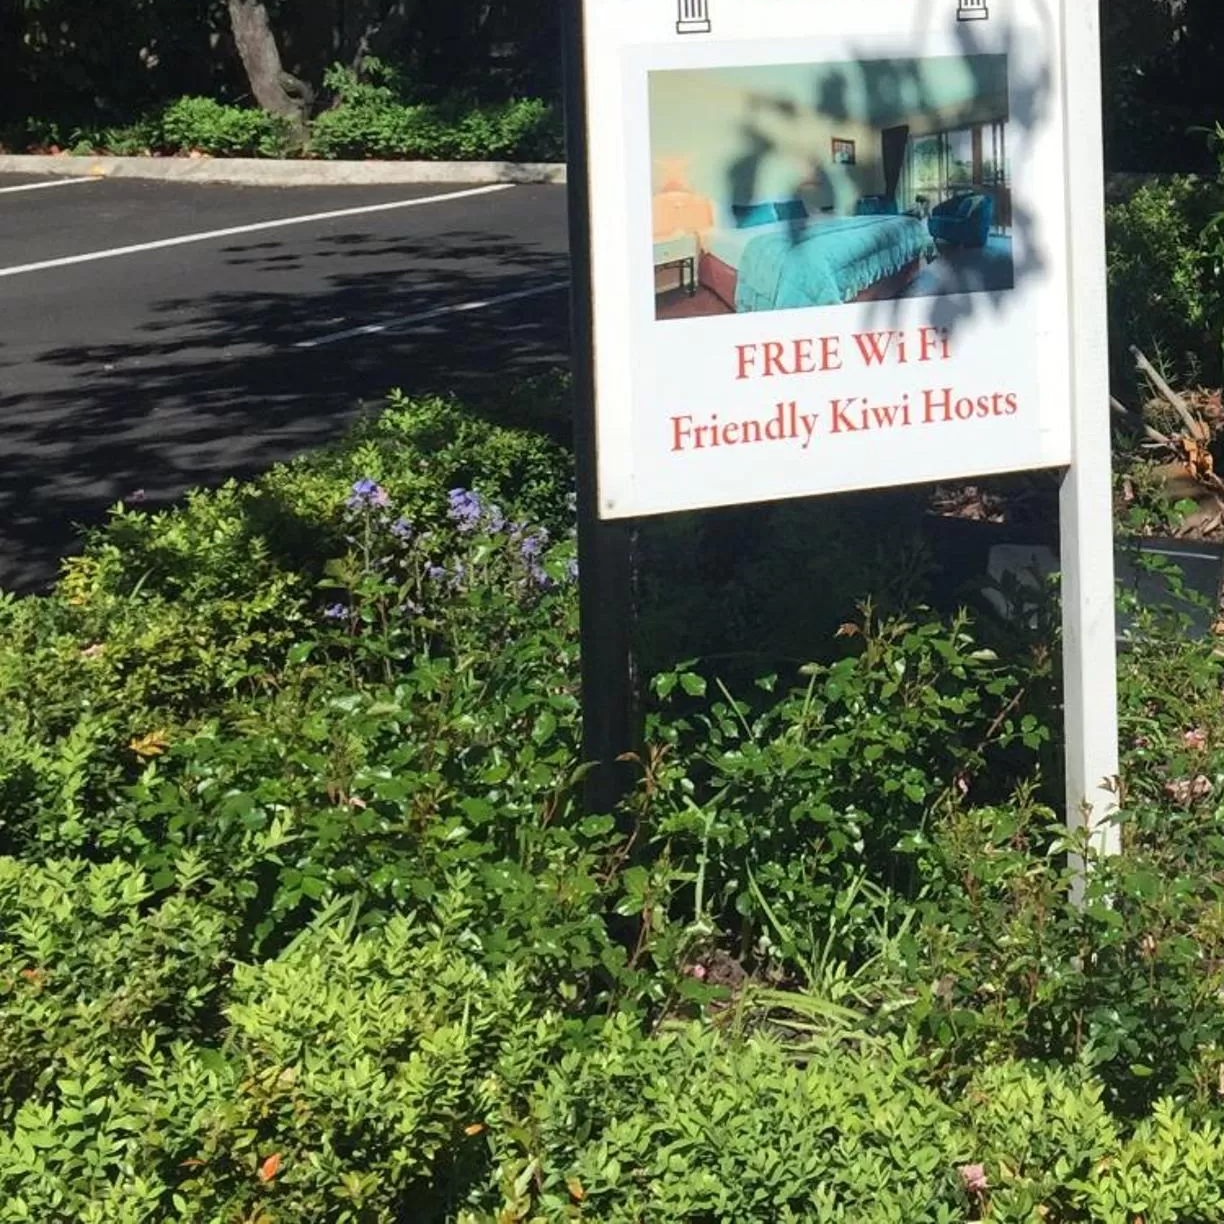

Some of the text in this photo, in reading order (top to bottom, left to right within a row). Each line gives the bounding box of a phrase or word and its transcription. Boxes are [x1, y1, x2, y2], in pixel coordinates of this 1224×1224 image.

[734, 326, 952, 381] FREE Wi Fi
[669, 387, 1018, 452] Friendly Kiwi Hosts
